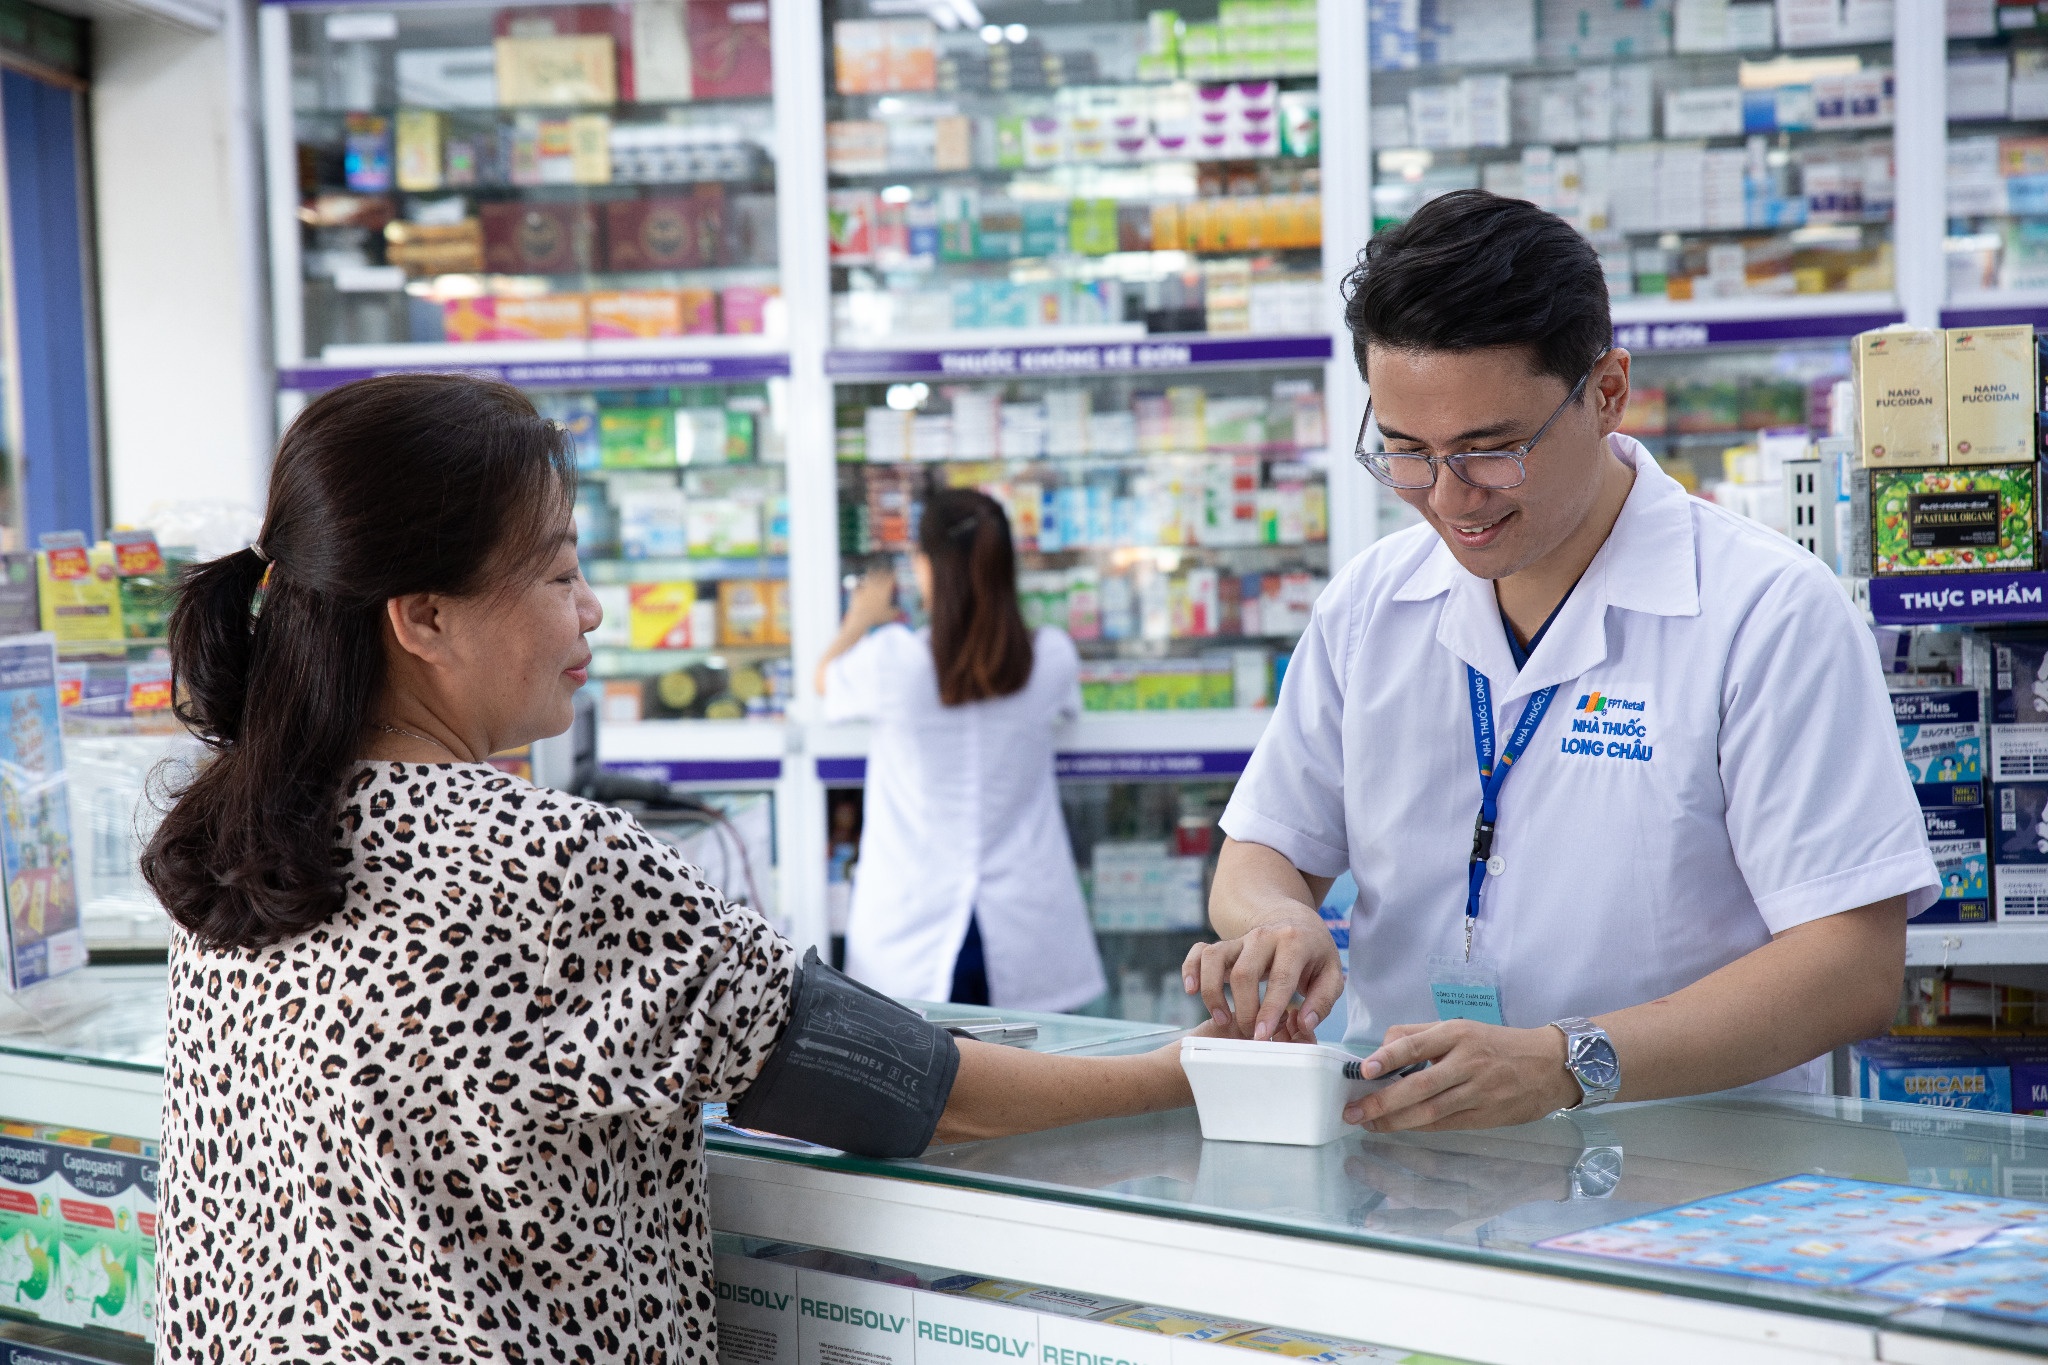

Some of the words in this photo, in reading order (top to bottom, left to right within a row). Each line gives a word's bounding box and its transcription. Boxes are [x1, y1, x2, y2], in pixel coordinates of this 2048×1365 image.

[1888, 388, 1921, 398] NANO
[1962, 392, 2020, 404] FUCOIDAN
[1974, 384, 2007, 394] NANO
[1876, 397, 1933, 408] FUCOIDAN
[1922, 512, 1960, 524] NATURAL
[1960, 510, 1996, 522] ORGANIC
[1901, 587, 1967, 612] THỰC
[1971, 581, 2042, 607] PHẨM
[1475, 677, 1487, 703] LONG
[1607, 698, 1622, 709] FPT
[1622, 699, 1645, 712] Retail
[1921, 701, 1950, 713] Plus
[1571, 716, 1599, 734] NHÀ
[1602, 717, 1646, 738] THUỐC
[1480, 737, 1492, 757] NHÀ
[1515, 728, 1530, 747] NHÀ
[1561, 737, 1604, 757] LONG
[1607, 738, 1653, 762] CHÂU
[1927, 818, 1957, 830] Plus
[850, 1051, 884, 1071] INDEX
[1904, 1074, 1986, 1095] URICARE
[63, 1152, 123, 1178] Captogastril
[75, 1175, 94, 1189] stick
[96, 1180, 116, 1194] pack
[800, 1297, 905, 1334] REDISOLV
[918, 1320, 1030, 1358] REDISOLV
